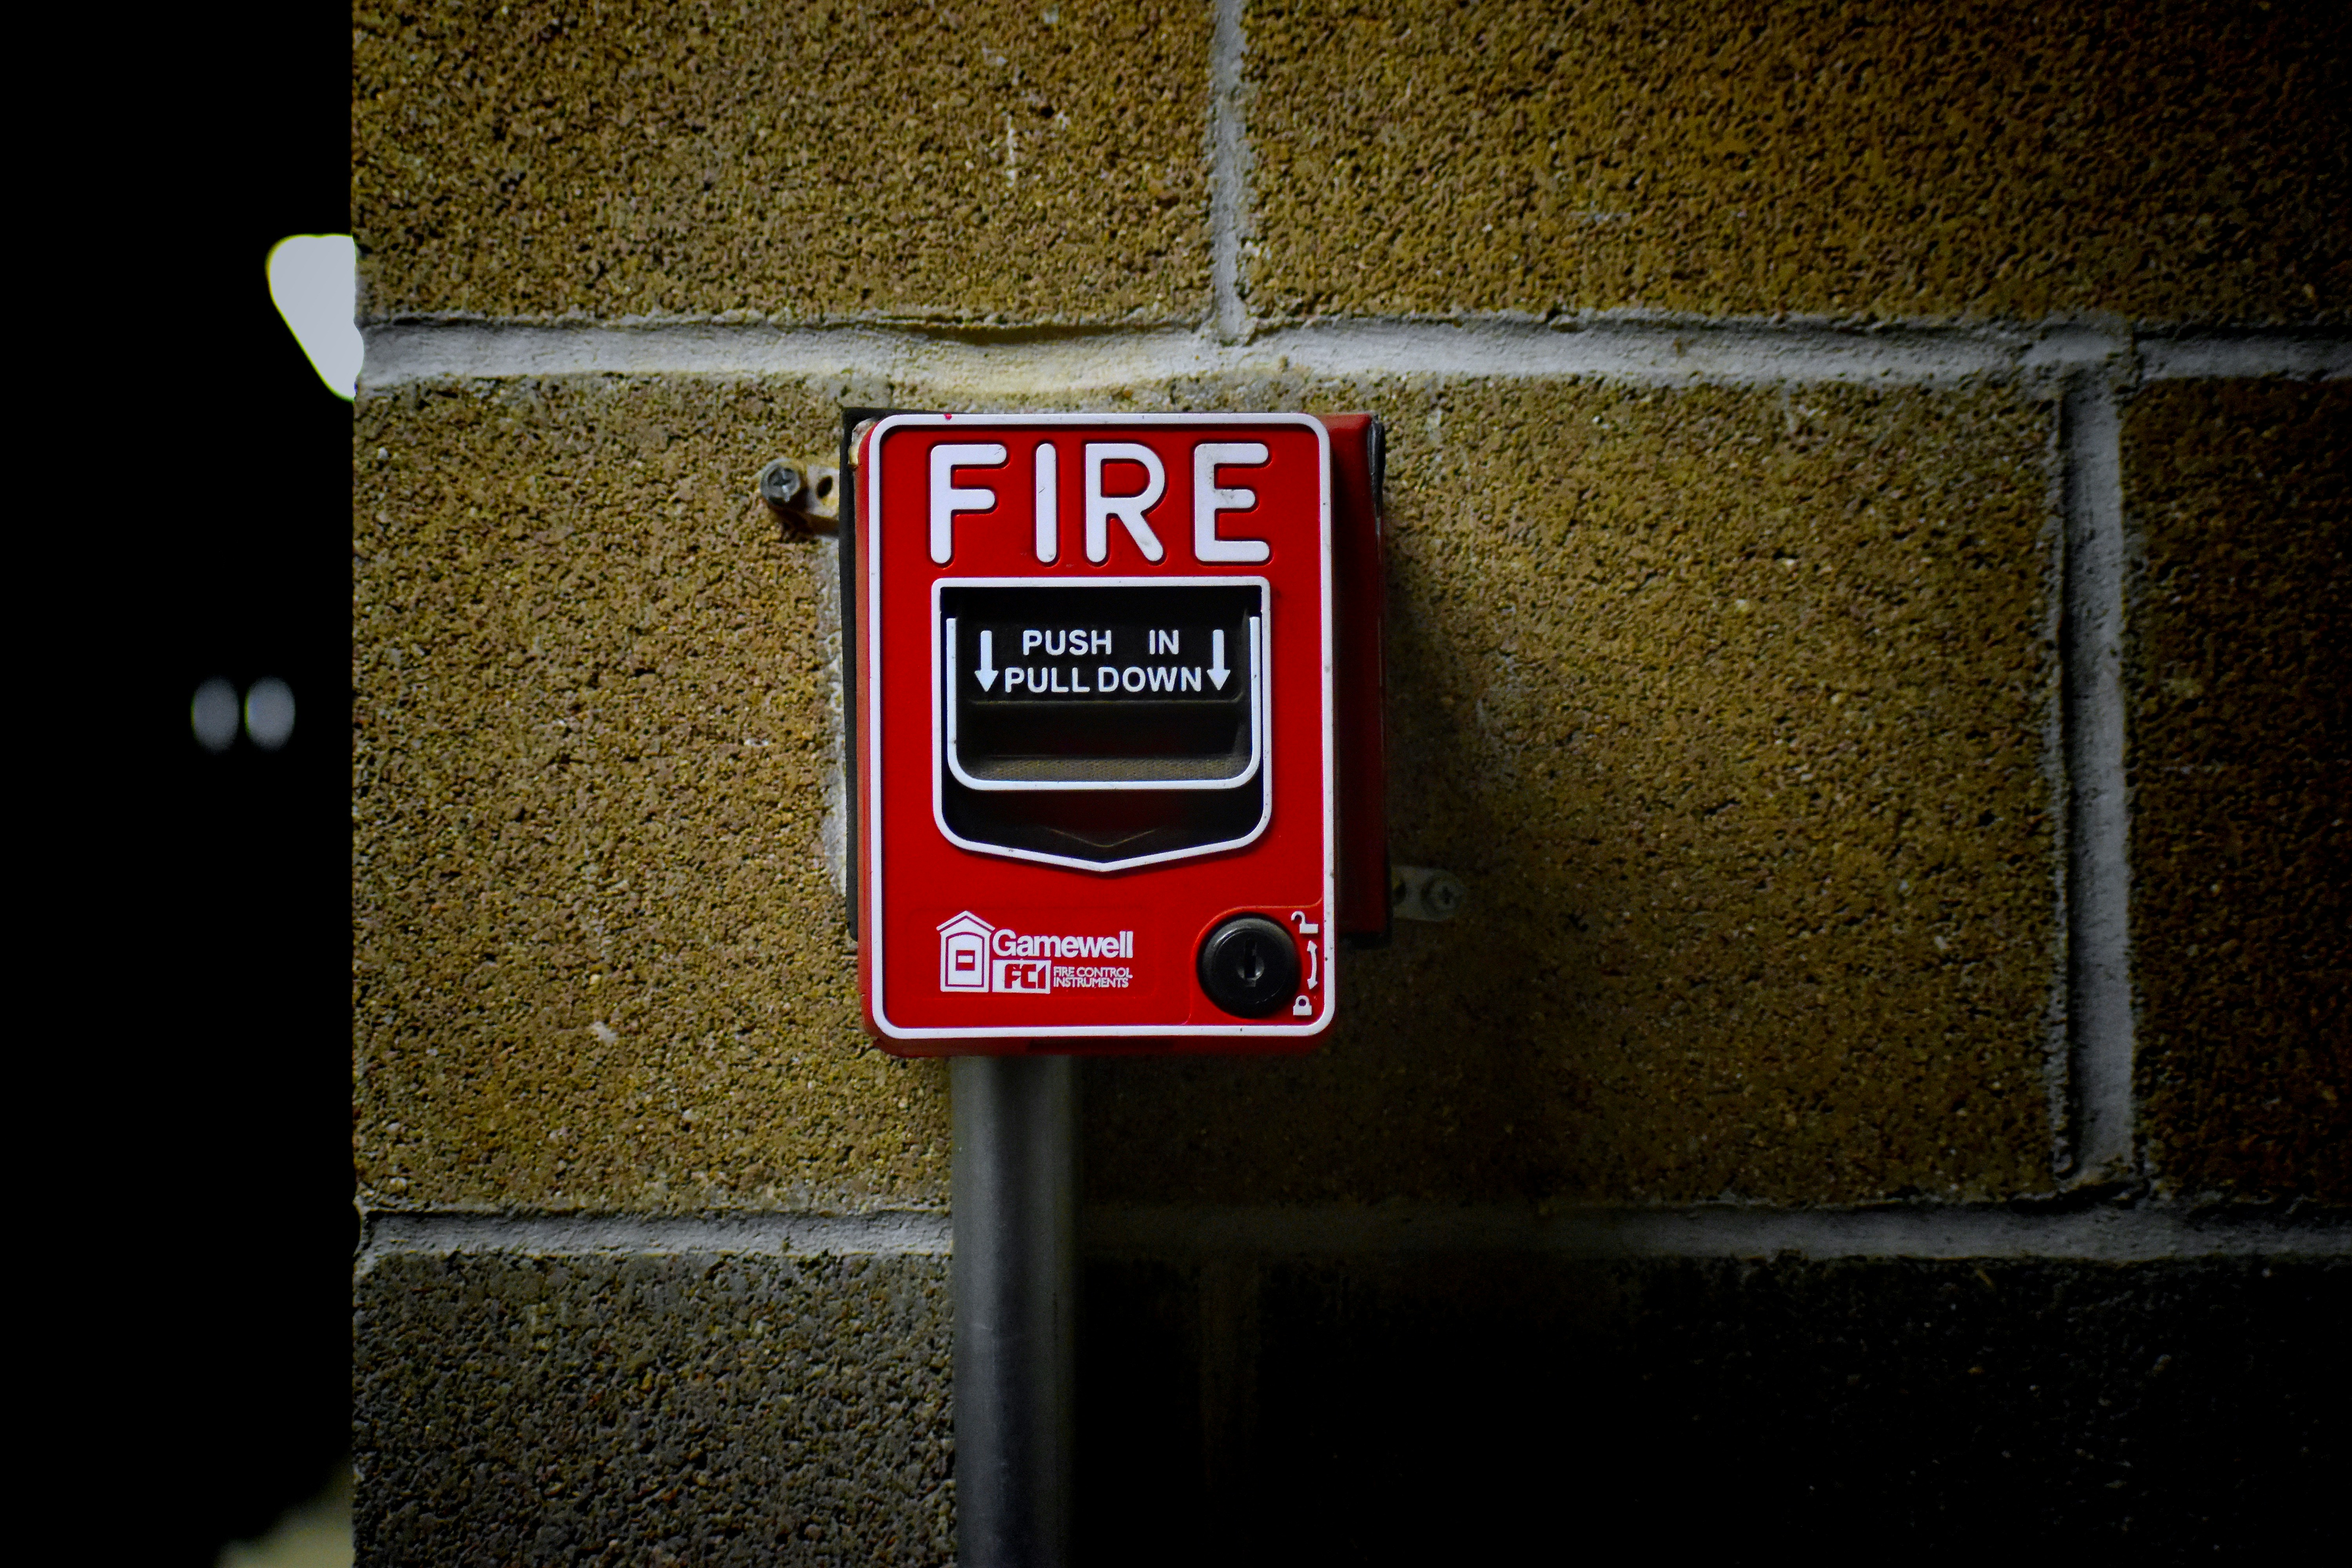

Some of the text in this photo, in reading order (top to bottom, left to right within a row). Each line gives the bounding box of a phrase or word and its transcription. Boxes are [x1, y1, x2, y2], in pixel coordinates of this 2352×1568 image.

[930, 443, 1270, 564] FIRE
[1022, 629, 1180, 656] PUSH IN
[1004, 666, 1202, 693] PULL DOWN
[992, 929, 1134, 958] Gamewell
[1053, 966, 1133, 979] FIRE CONTROL
[1053, 977, 1129, 988] INSTRUMENTS
